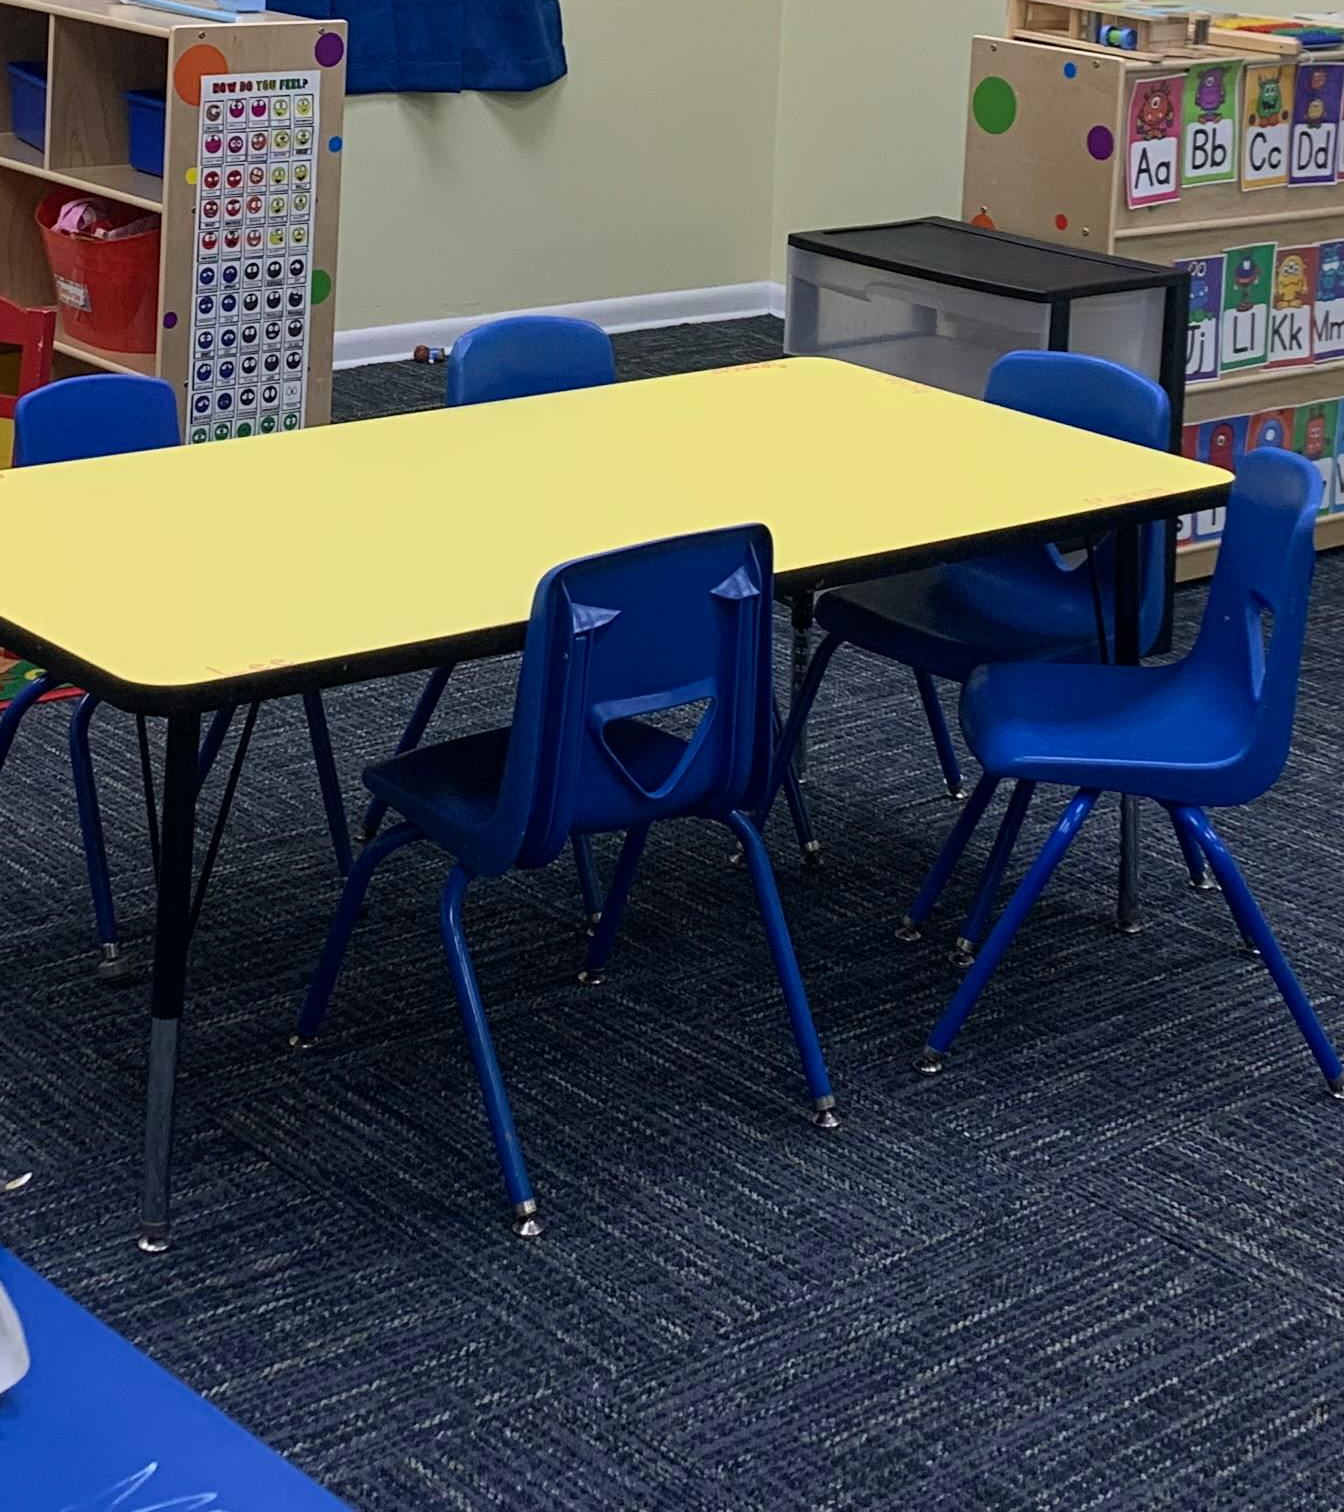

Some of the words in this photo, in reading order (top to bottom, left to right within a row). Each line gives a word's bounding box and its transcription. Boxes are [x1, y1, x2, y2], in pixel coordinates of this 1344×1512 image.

[213, 81, 237, 94] HOW
[239, 80, 253, 92] DO
[256, 79, 277, 91] YOU
[279, 78, 309, 90] FEEL?
[1134, 147, 1171, 189] Aa
[1191, 128, 1227, 170] Bb
[1249, 131, 1282, 171] Cc
[1297, 131, 1331, 170] Dd
[1233, 312, 1256, 354] Ll
[1270, 312, 1303, 353] Kk
